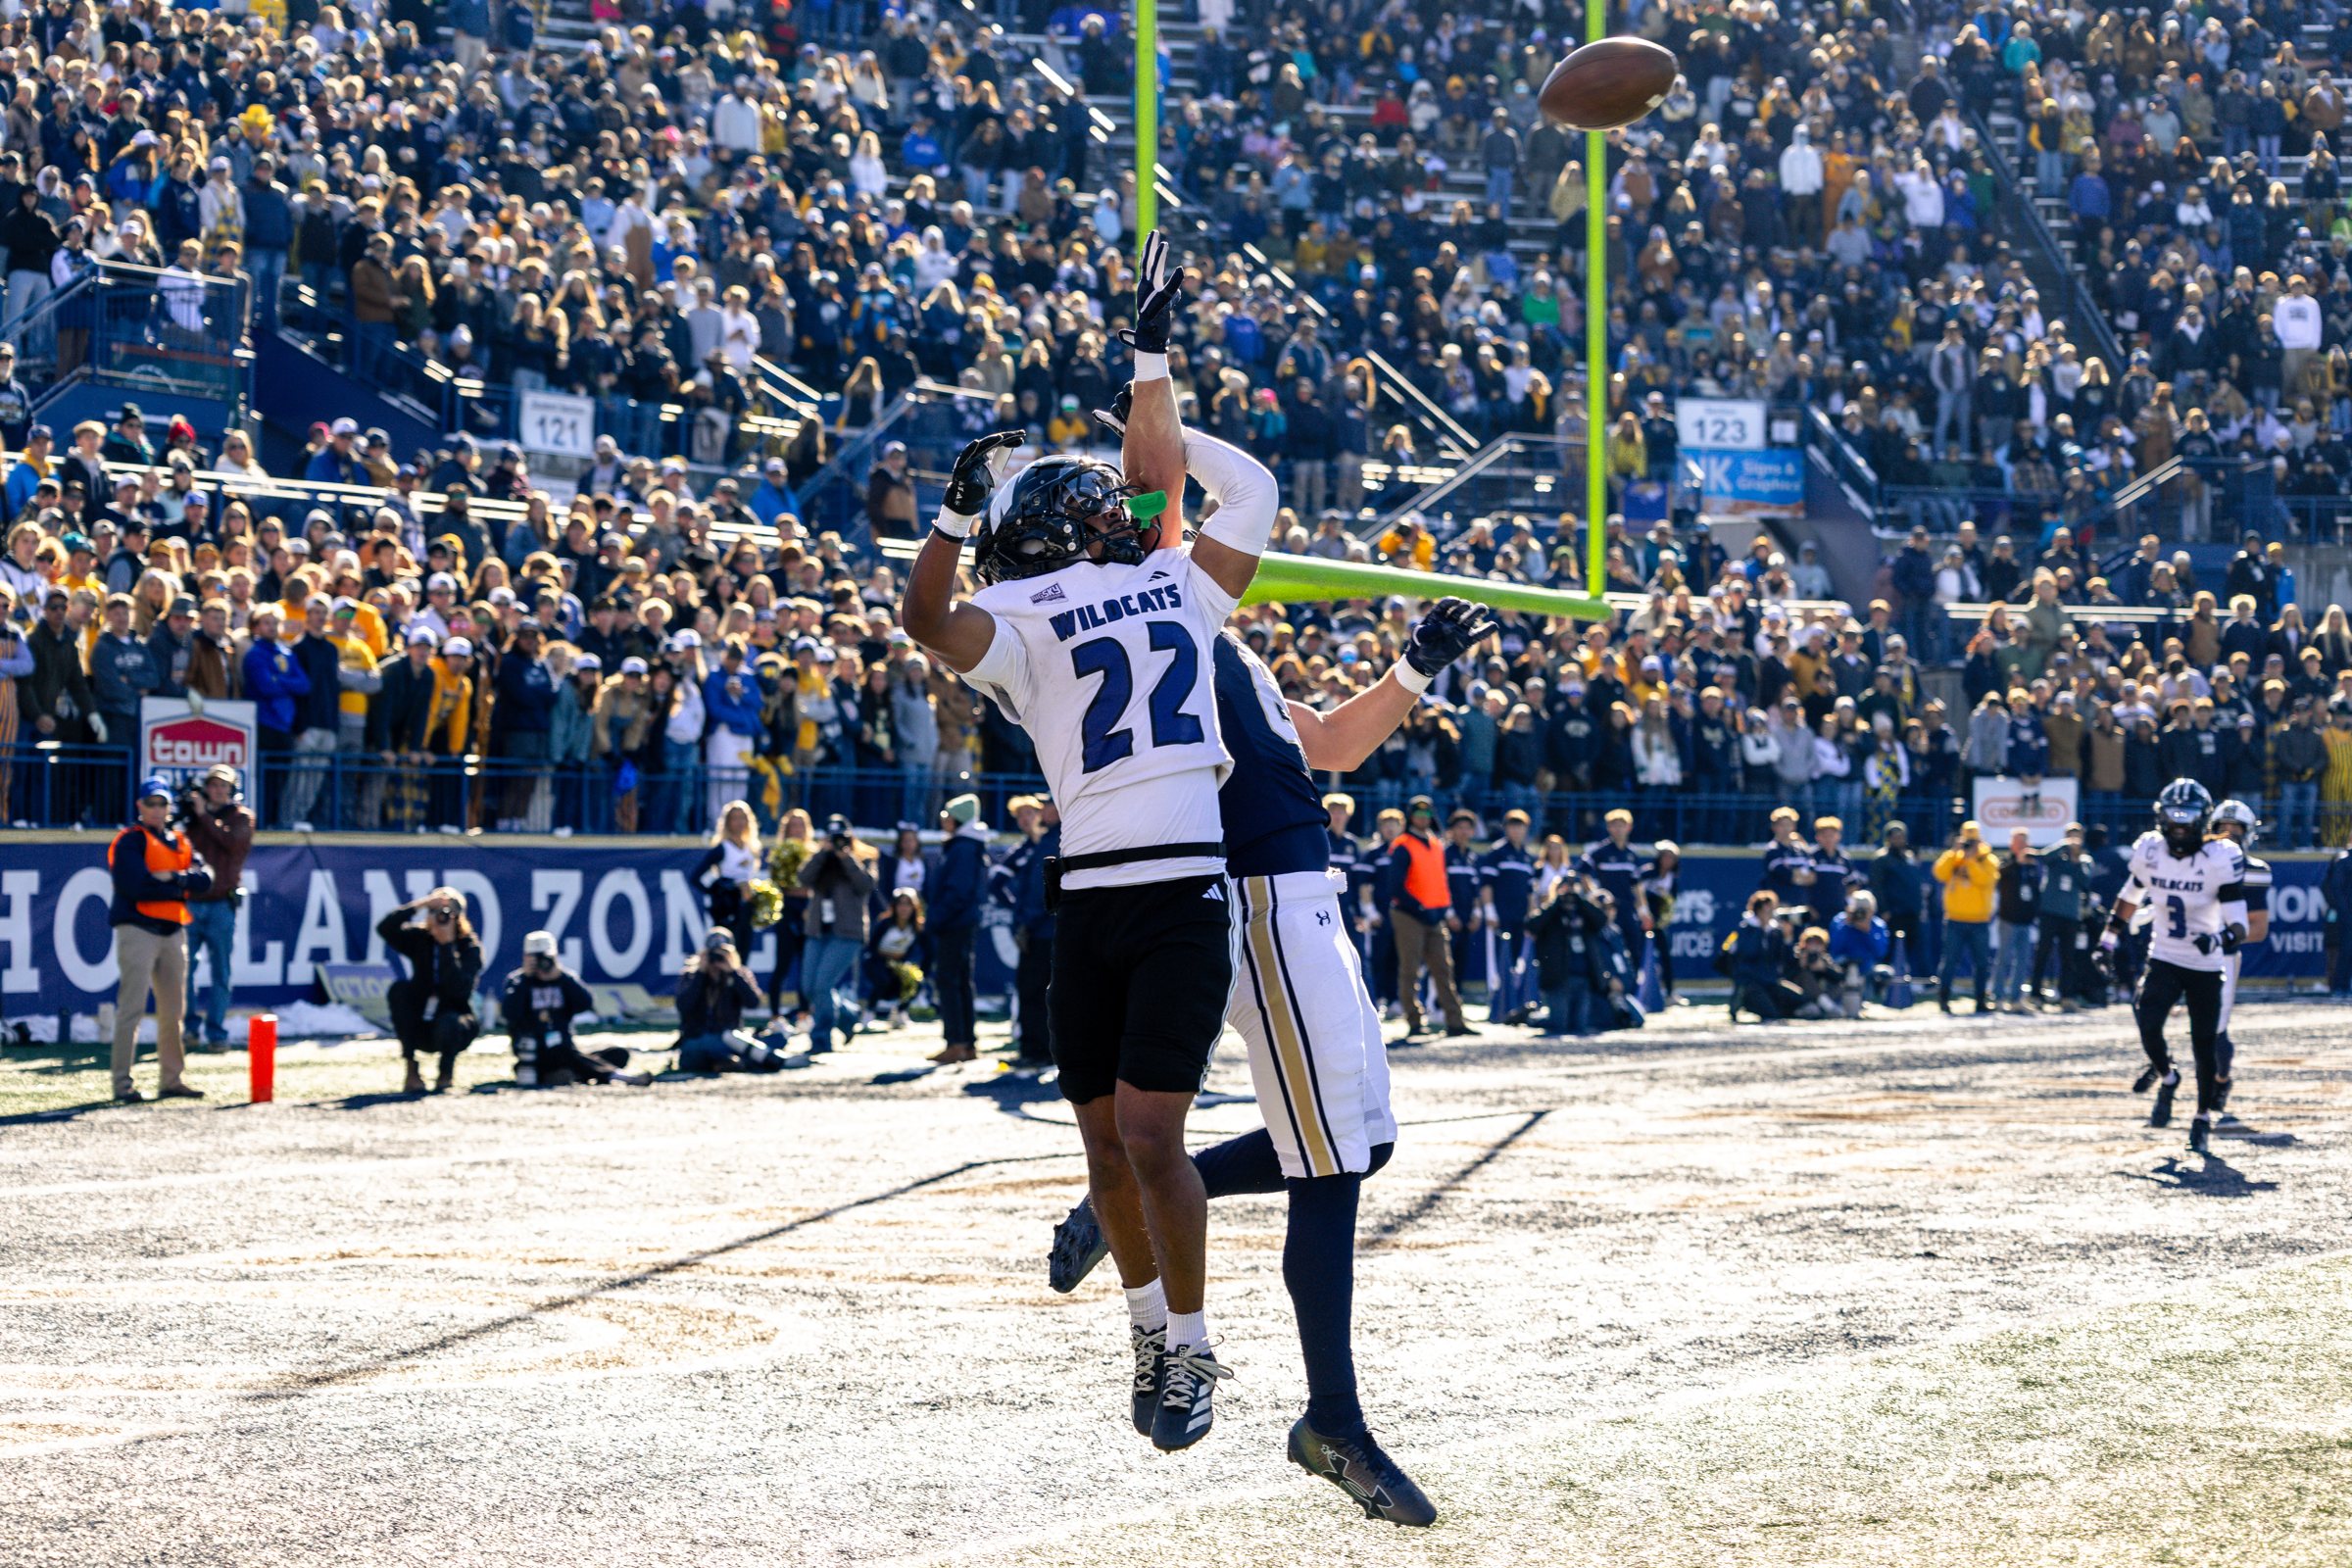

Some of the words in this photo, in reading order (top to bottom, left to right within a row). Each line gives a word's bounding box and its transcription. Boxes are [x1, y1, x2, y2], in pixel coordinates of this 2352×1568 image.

[536, 416, 579, 447] 121
[1693, 418, 1747, 443] 123
[1049, 583, 1182, 642] WILDCATS
[1070, 620, 1204, 774] 22
[152, 733, 242, 763] town
[2150, 876, 2204, 893] WILDCATS
[531, 866, 778, 979] ZON
[2167, 895, 2186, 940] 3
[2270, 931, 2325, 954] VISIT
